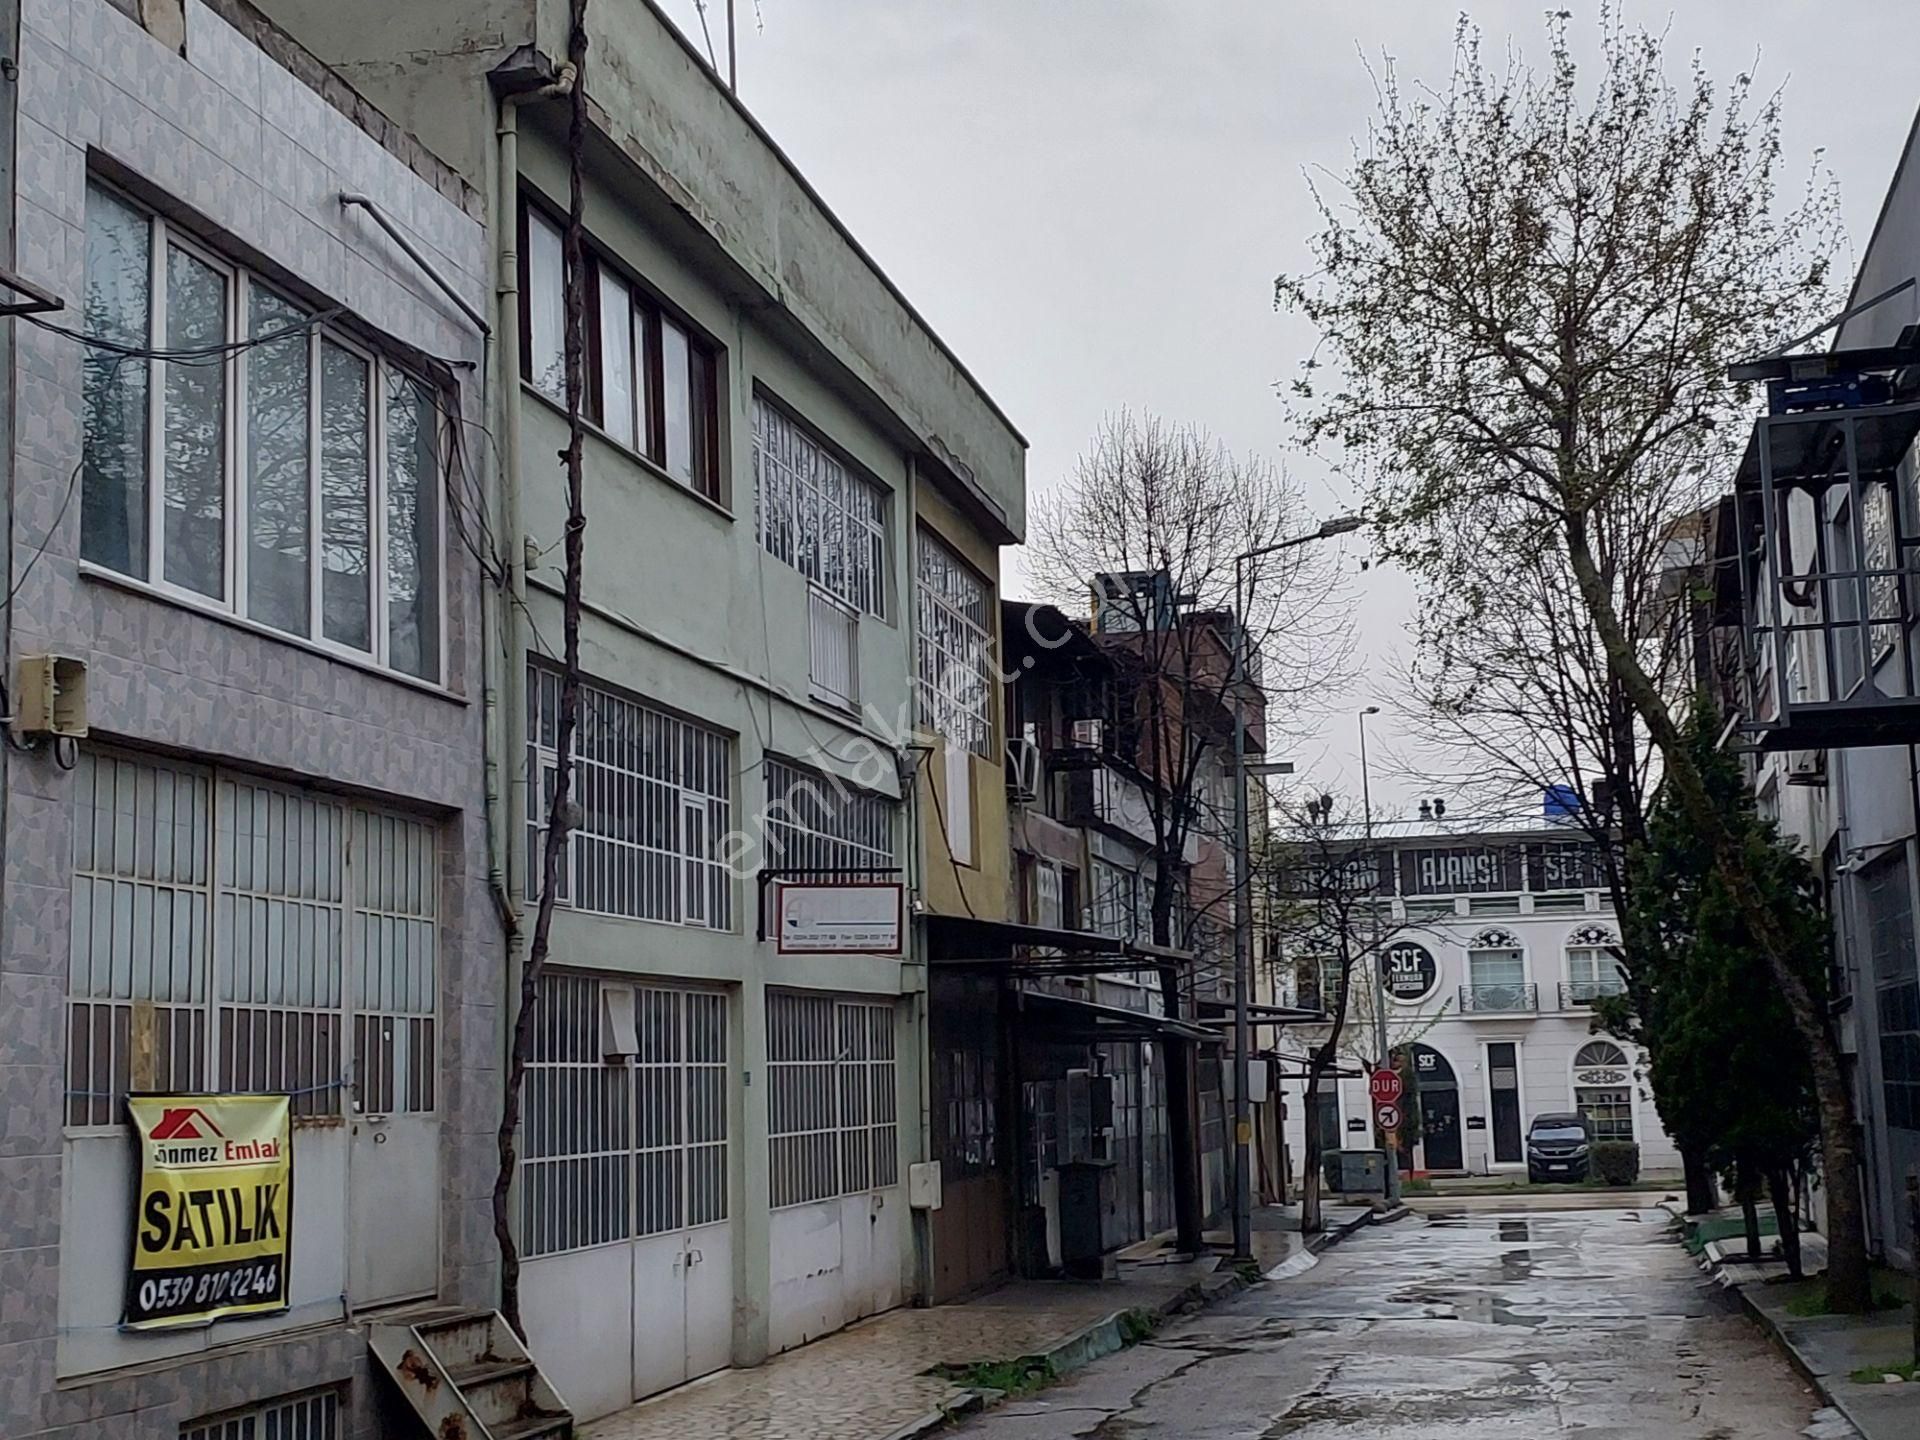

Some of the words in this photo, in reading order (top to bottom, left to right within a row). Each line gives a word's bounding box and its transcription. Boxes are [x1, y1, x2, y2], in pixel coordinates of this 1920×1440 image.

[1422, 853, 1499, 887] AJANSI
[1390, 949, 1423, 973] SCF
[1418, 1054, 1437, 1067] SCF
[1372, 1079, 1399, 1093] DUR
[153, 1143, 218, 1164] önmez
[224, 1137, 281, 1161] Emlak
[140, 1183, 281, 1253] SATILIK
[139, 1275, 194, 1312] 0539
